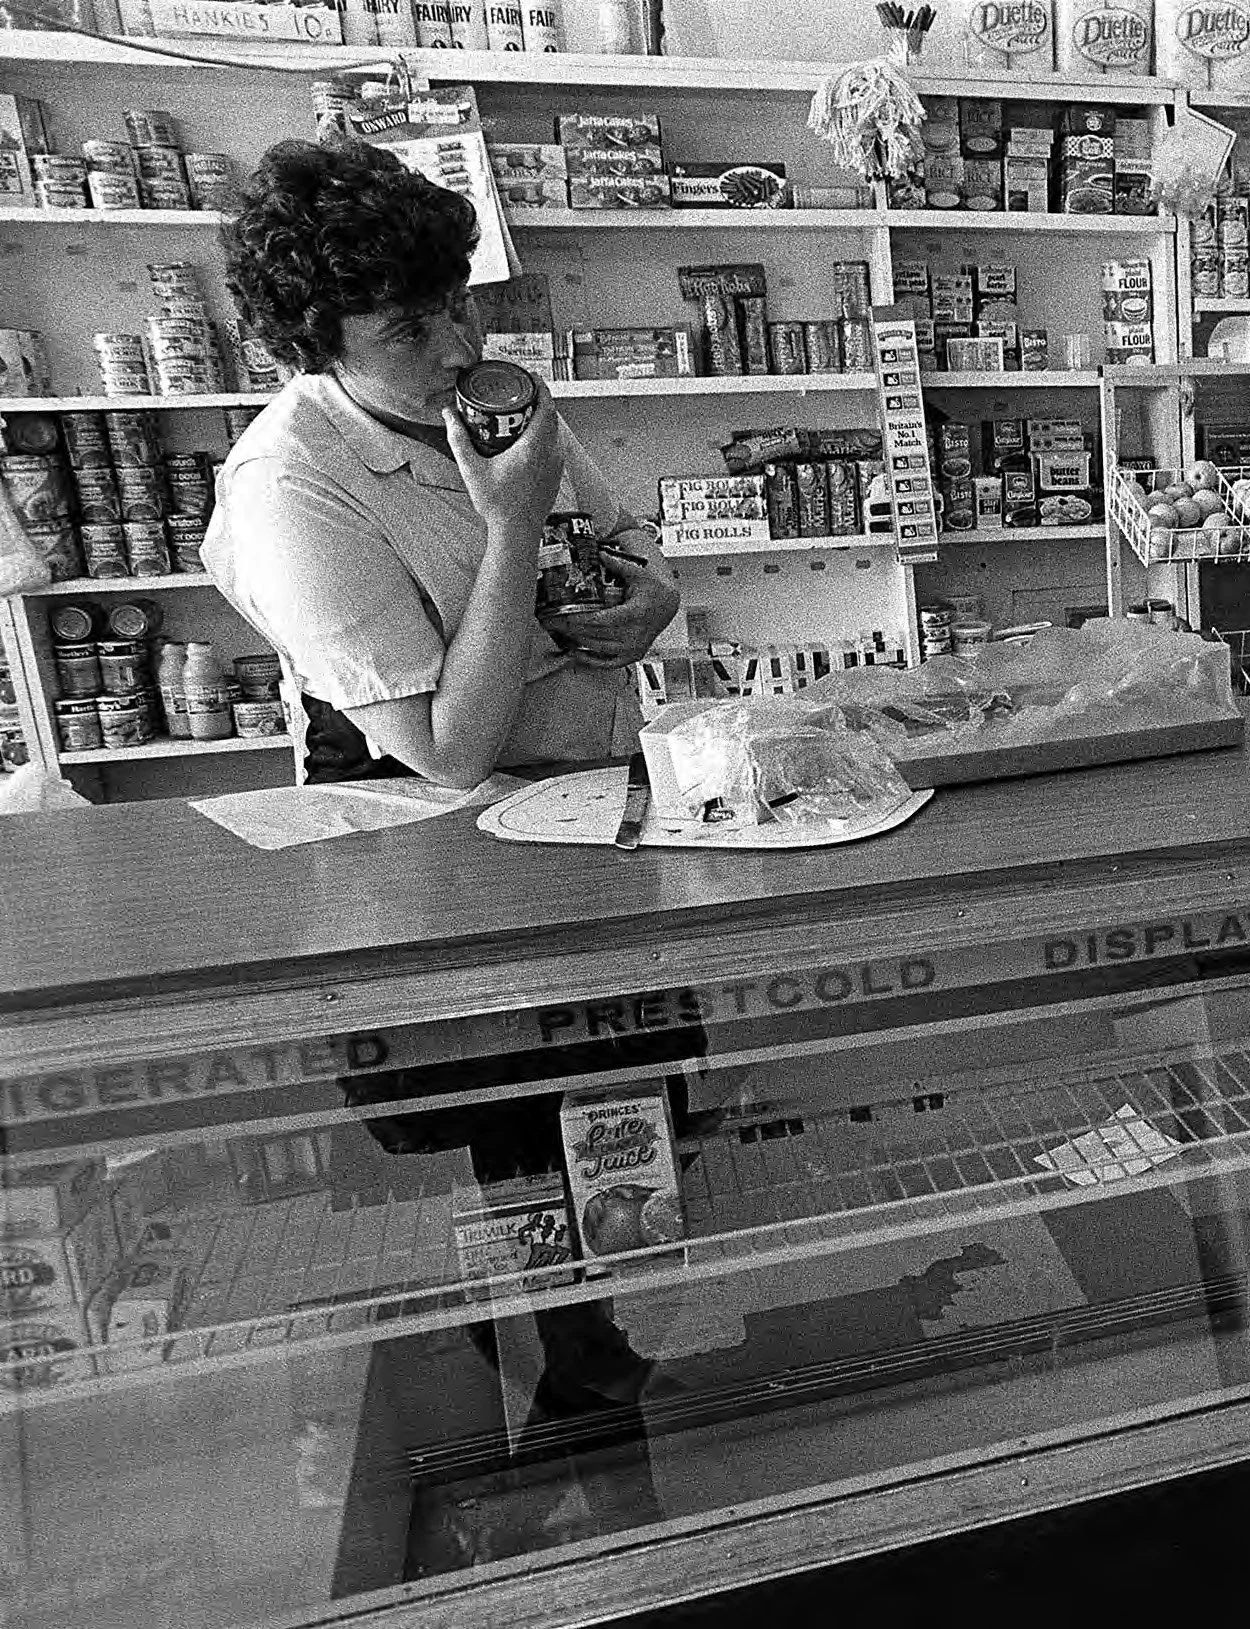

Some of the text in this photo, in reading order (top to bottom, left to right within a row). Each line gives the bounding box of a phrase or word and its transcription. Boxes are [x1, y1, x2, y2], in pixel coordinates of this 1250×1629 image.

[173, 5, 269, 32] HANKIES
[979, 0, 1044, 33] Duette
[1185, 8, 1247, 41] Duette
[1084, 14, 1144, 46] Duette
[361, 112, 407, 133] ONWARD
[672, 181, 719, 194] Fingers
[1118, 277, 1148, 289] FLOUR
[1122, 334, 1151, 346] FLOUR
[893, 439, 922, 448] Match
[679, 481, 702, 500] FIG
[681, 501, 705, 520] FIG
[675, 526, 751, 543] FIG ROLLS
[10, 1036, 390, 1118] IGERATED
[538, 959, 936, 1042] PRESTCOLD
[580, 1141, 657, 1180] Juice
